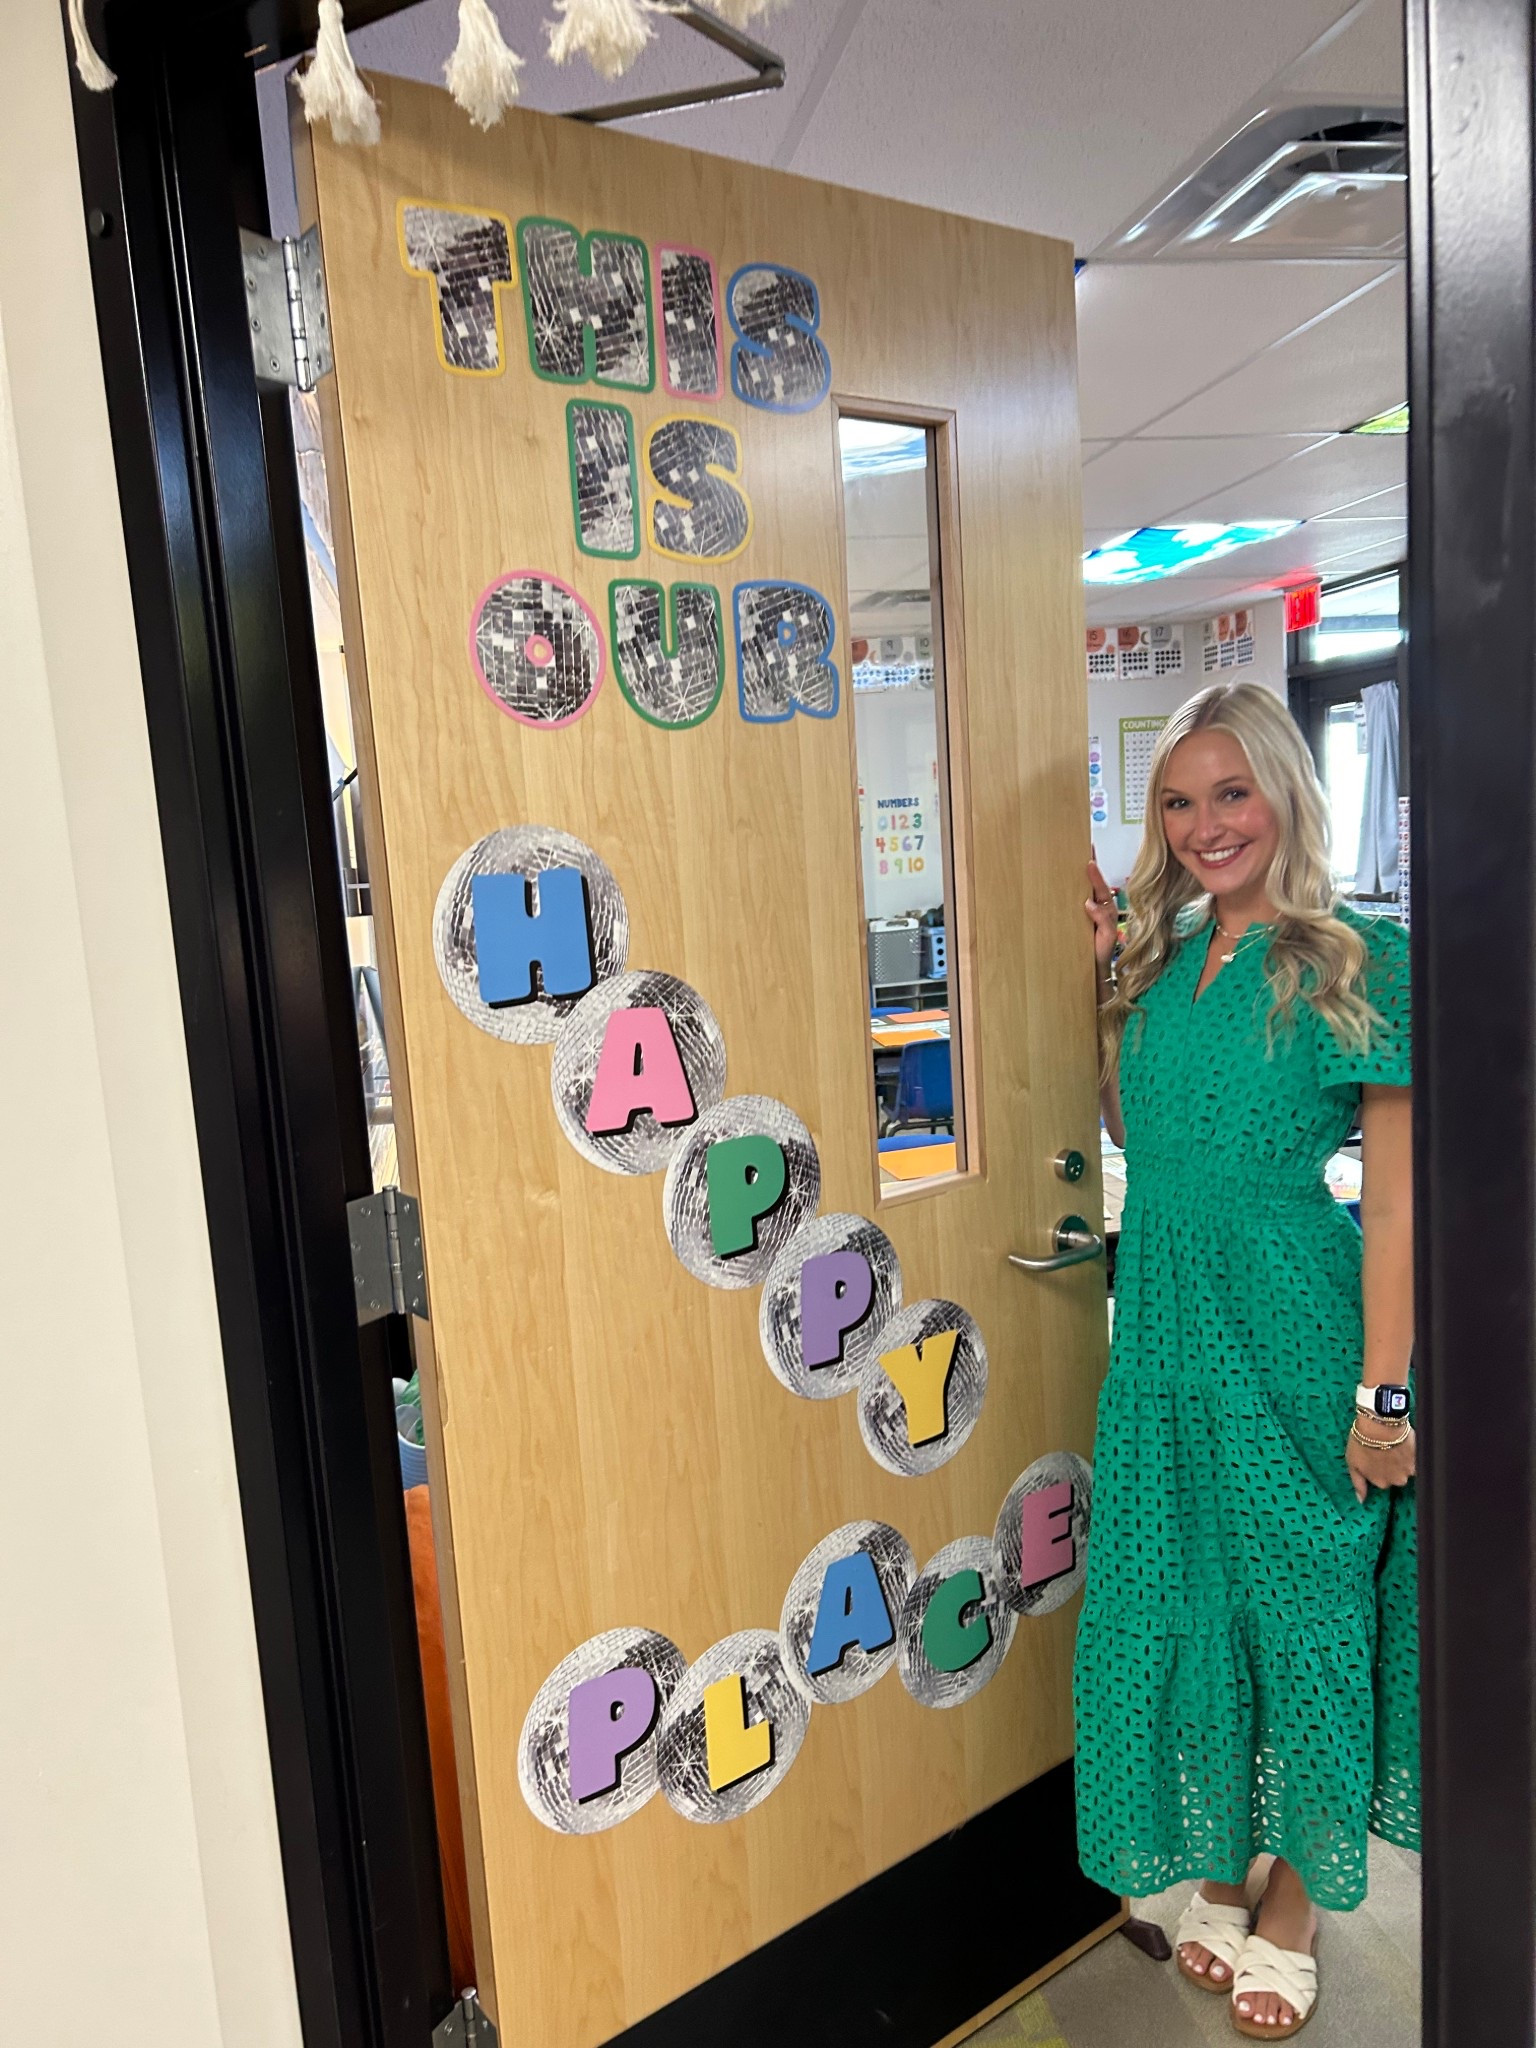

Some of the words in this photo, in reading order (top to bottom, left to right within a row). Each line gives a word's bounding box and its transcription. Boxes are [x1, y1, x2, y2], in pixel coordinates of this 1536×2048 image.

[396, 197, 832, 414] THIS
[566, 397, 754, 564] IS
[469, 569, 840, 730] OUR
[875, 836, 886, 854] 4
[889, 836, 899, 852] 5
[902, 835, 912, 852] 6
[914, 834, 924, 851] 7
[877, 797, 920, 809] NUMBERS
[877, 815, 888, 831] 0
[890, 814, 897, 831] 1
[898, 814, 910, 830] 2
[912, 812, 922, 829] 3
[879, 859, 889, 875] 8
[894, 857, 904, 874] 9
[907, 856, 925, 873] 10
[472, 867, 962, 1449] HAPPY
[569, 1481, 1077, 1805] PLACE
